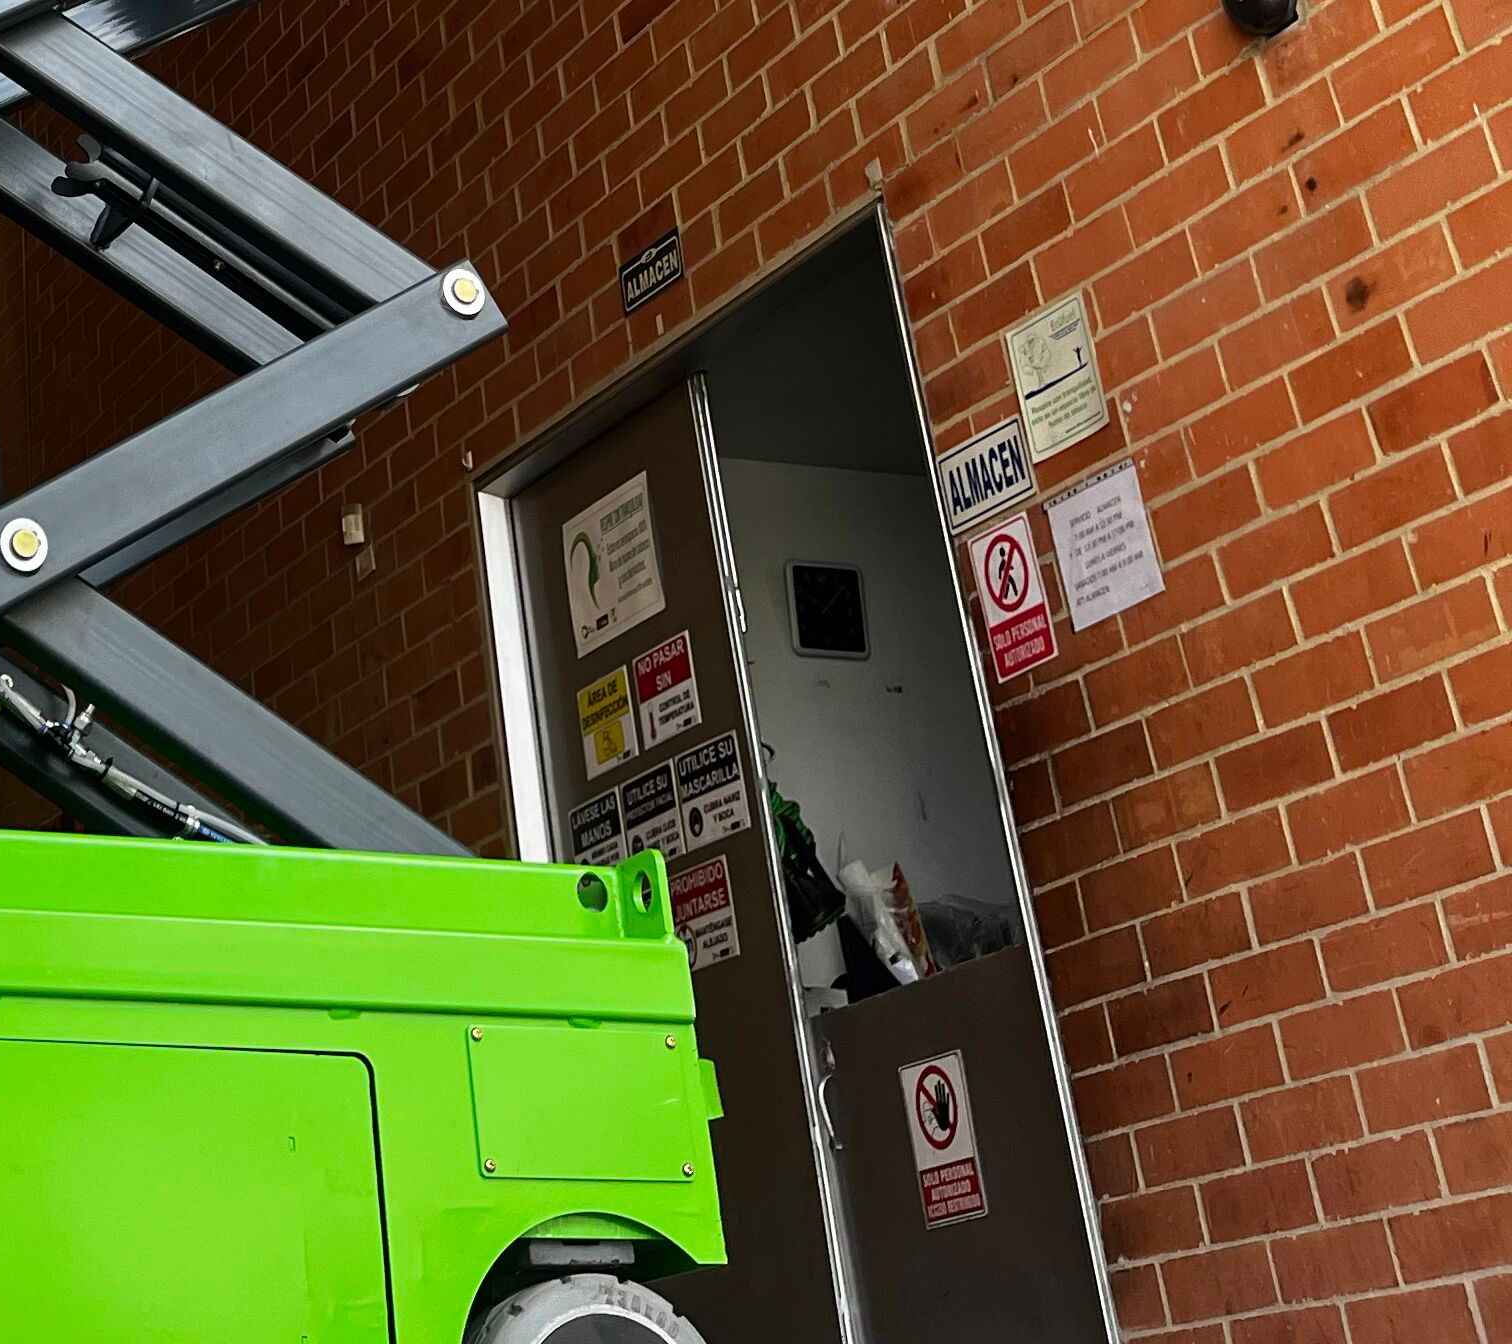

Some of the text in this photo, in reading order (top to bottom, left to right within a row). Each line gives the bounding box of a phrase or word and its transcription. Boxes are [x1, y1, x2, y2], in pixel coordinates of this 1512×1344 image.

[627, 249, 678, 303] ALMACEN
[948, 435, 1026, 516] ALMACEN
[993, 613, 1047, 651] SOLO PERSONAL
[637, 639, 684, 676] NO PASAR
[1004, 635, 1045, 668] AUTORIZADO
[607, 679, 618, 698] DE
[655, 671, 672, 691] SIN
[678, 738, 733, 777] UTILICE SU
[626, 773, 668, 806] UTILICE SU
[680, 762, 740, 799] MASCARILLA
[600, 795, 616, 815] LAS
[581, 819, 612, 848] MANOS
[670, 862, 724, 896] PROHIBIDO
[675, 887, 727, 923] JUNTARSE
